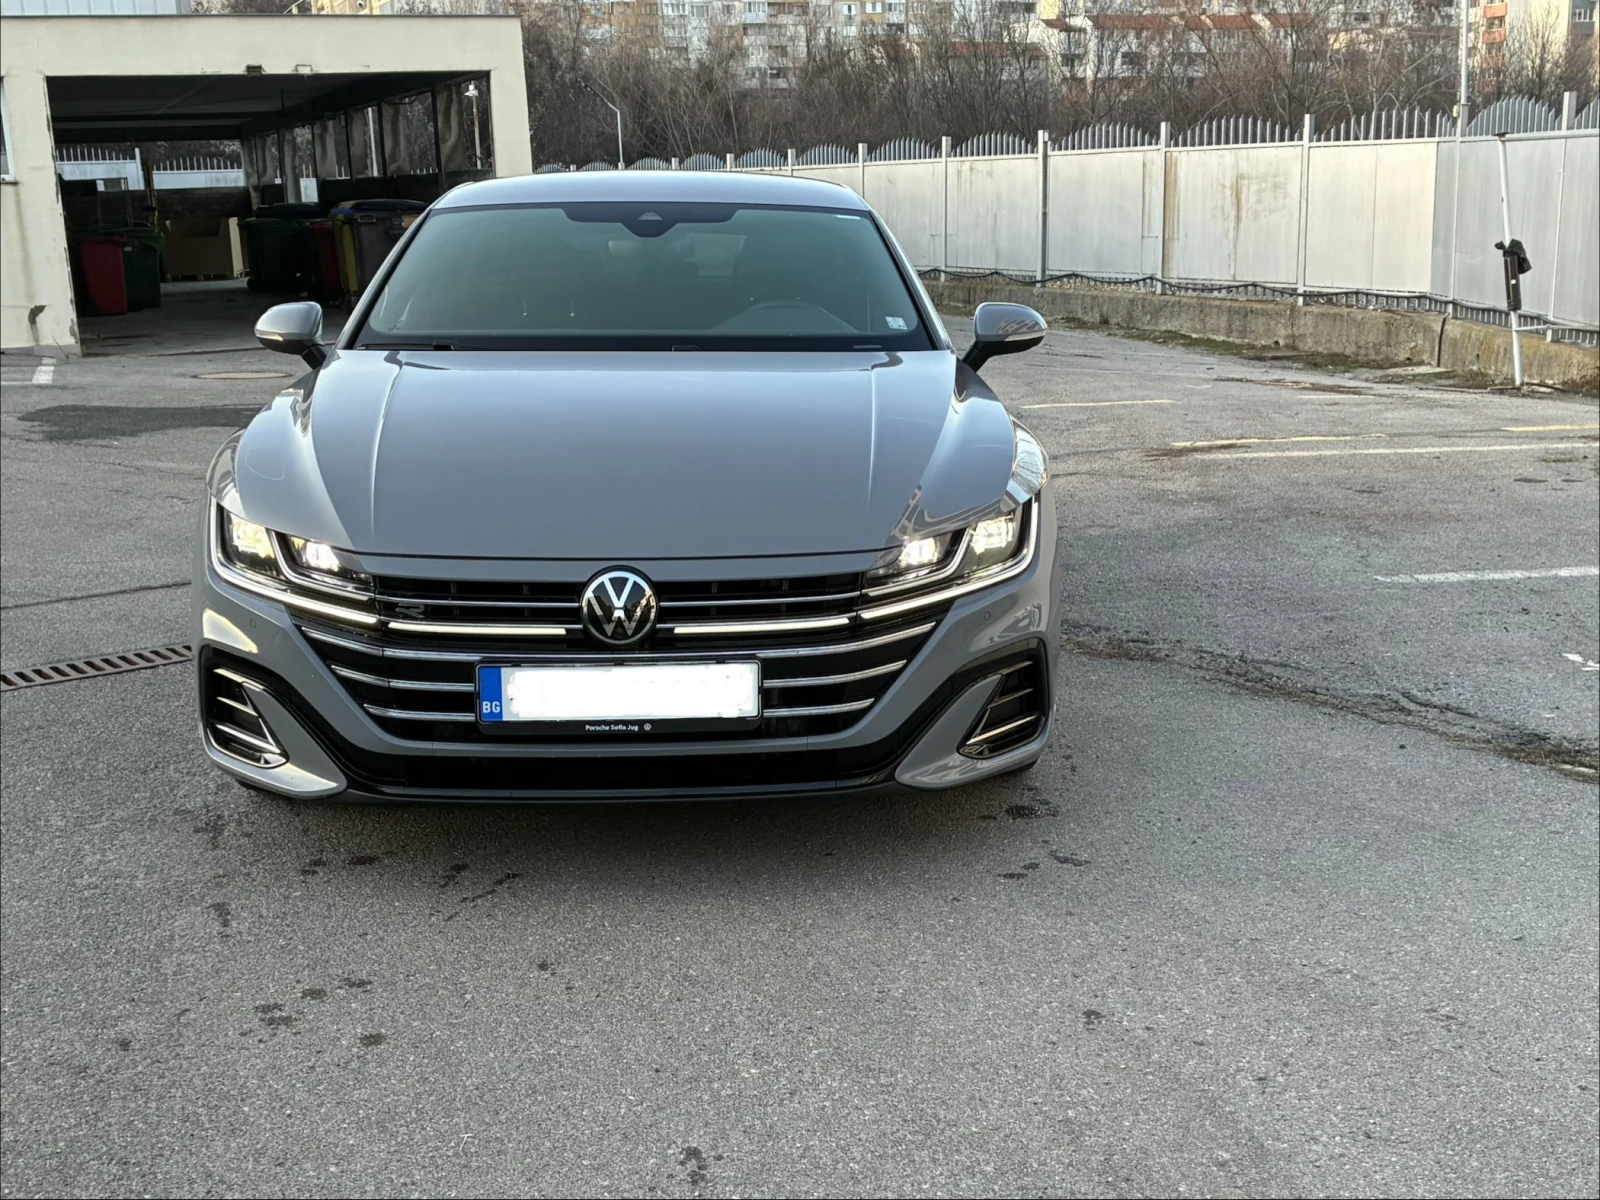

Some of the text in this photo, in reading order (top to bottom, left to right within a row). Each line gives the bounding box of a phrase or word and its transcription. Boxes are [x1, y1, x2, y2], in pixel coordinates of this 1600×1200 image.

[583, 571, 656, 643] VW
[482, 701, 501, 714] BG
[627, 724, 639, 732] Jug
